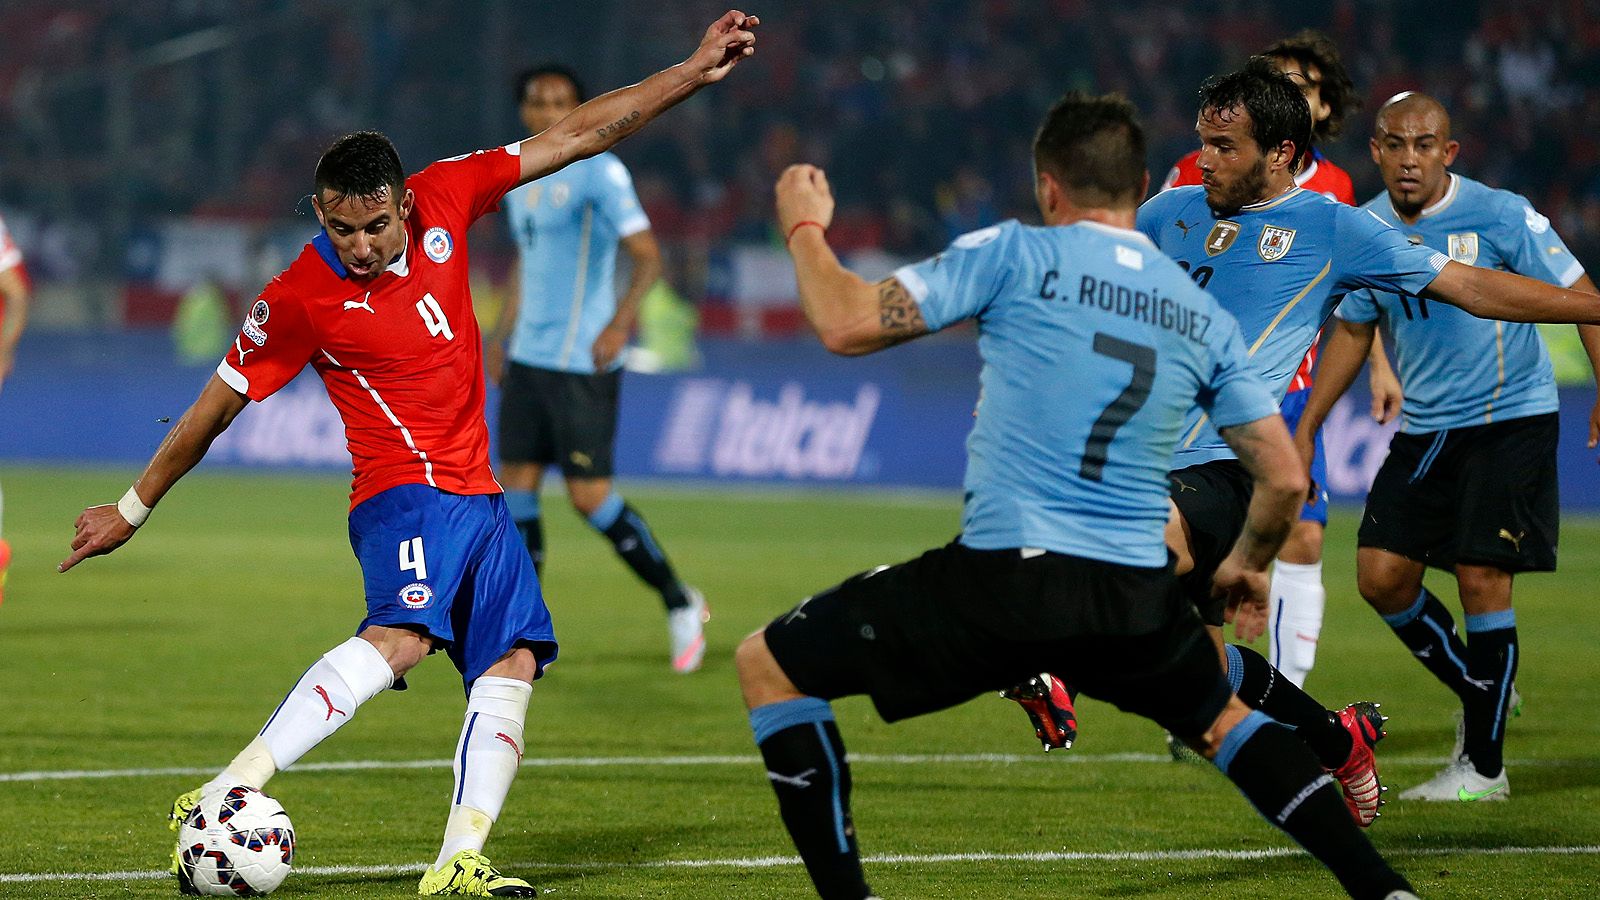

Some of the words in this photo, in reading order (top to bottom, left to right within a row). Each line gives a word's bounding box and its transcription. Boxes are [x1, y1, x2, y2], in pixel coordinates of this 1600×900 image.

[415, 292, 454, 341] 4
[1039, 270, 1068, 301] C.
[1079, 275, 1212, 346] RODRÍGUEZ
[1079, 332, 1157, 482] 7
[399, 536, 428, 580] 4
